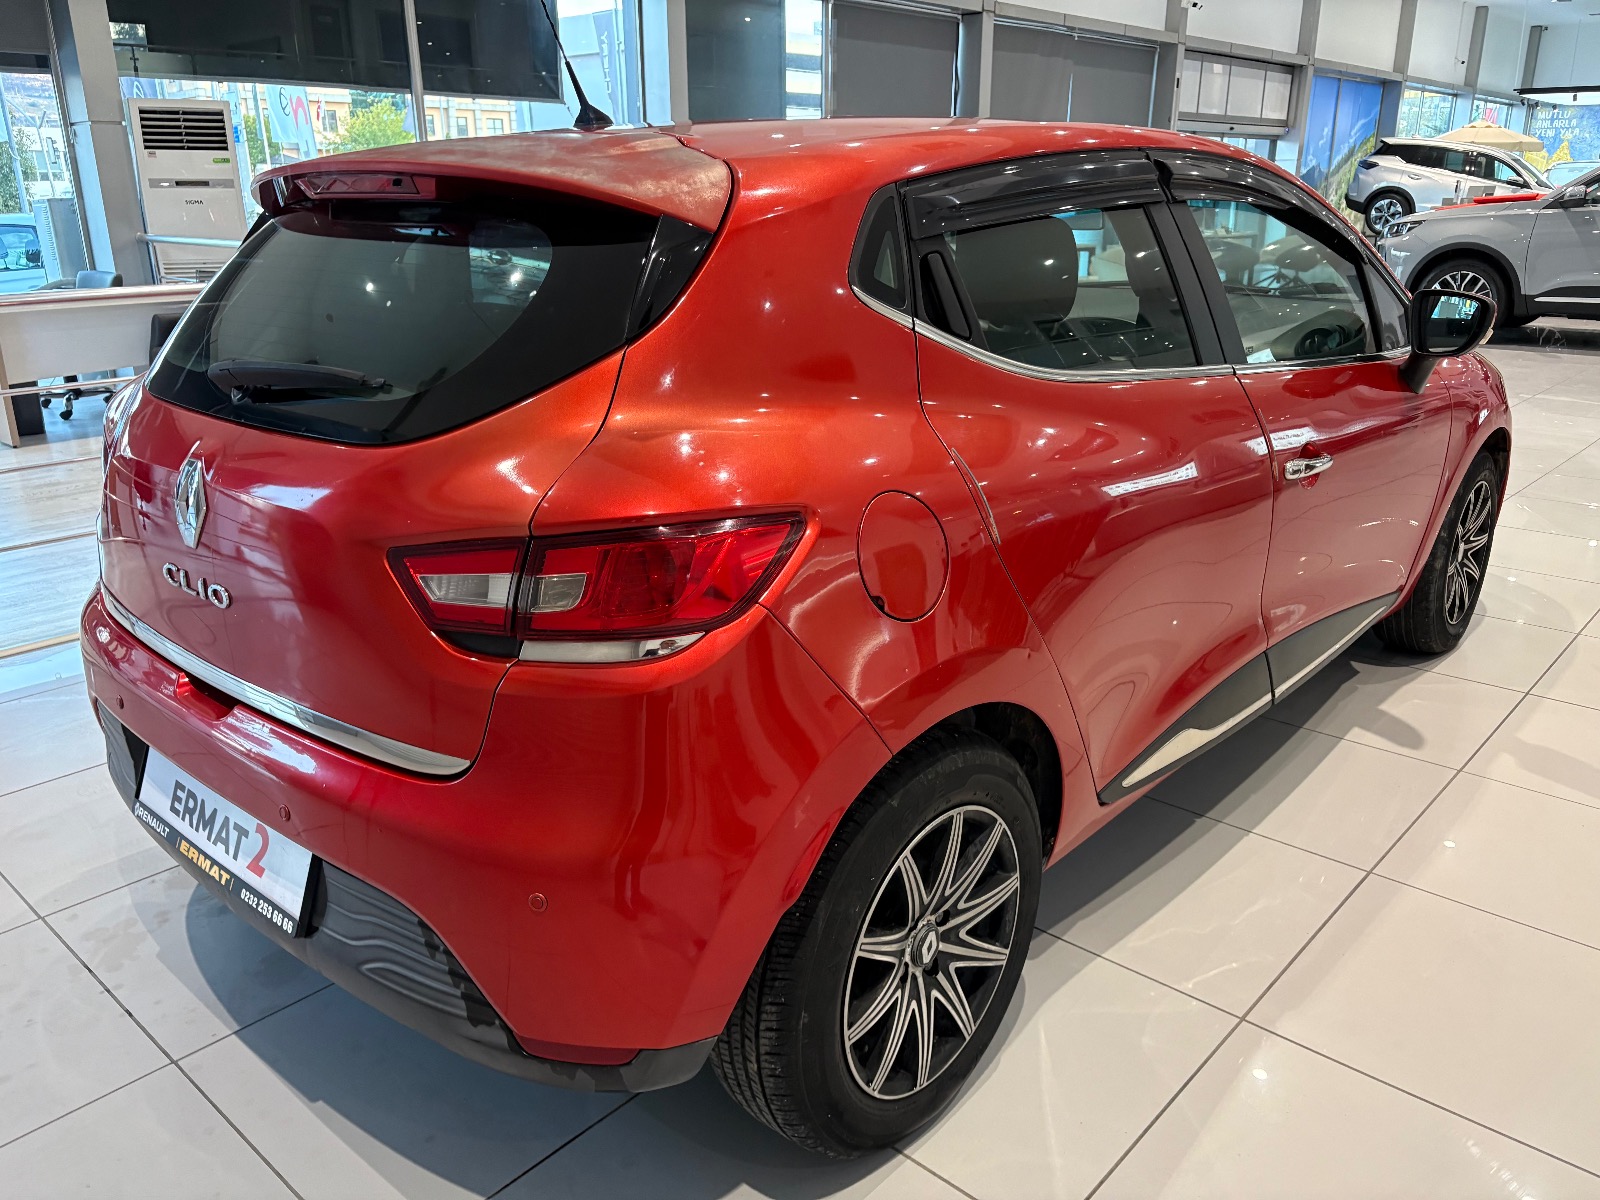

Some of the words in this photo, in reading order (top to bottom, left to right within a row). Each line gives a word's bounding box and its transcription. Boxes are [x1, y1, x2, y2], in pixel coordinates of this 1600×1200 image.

[1536, 119, 1577, 128] ANLARLA
[1538, 110, 1571, 119] MUTLU
[162, 561, 233, 610] CLIO
[138, 806, 169, 837] RENAULT
[169, 779, 250, 862] ERMAT
[245, 822, 270, 879] 2
[178, 839, 231, 887] ERMAT
[240, 888, 258, 909] 0232
[258, 900, 273, 919] 253
[272, 910, 283, 927] 66
[282, 917, 293, 935] 66
